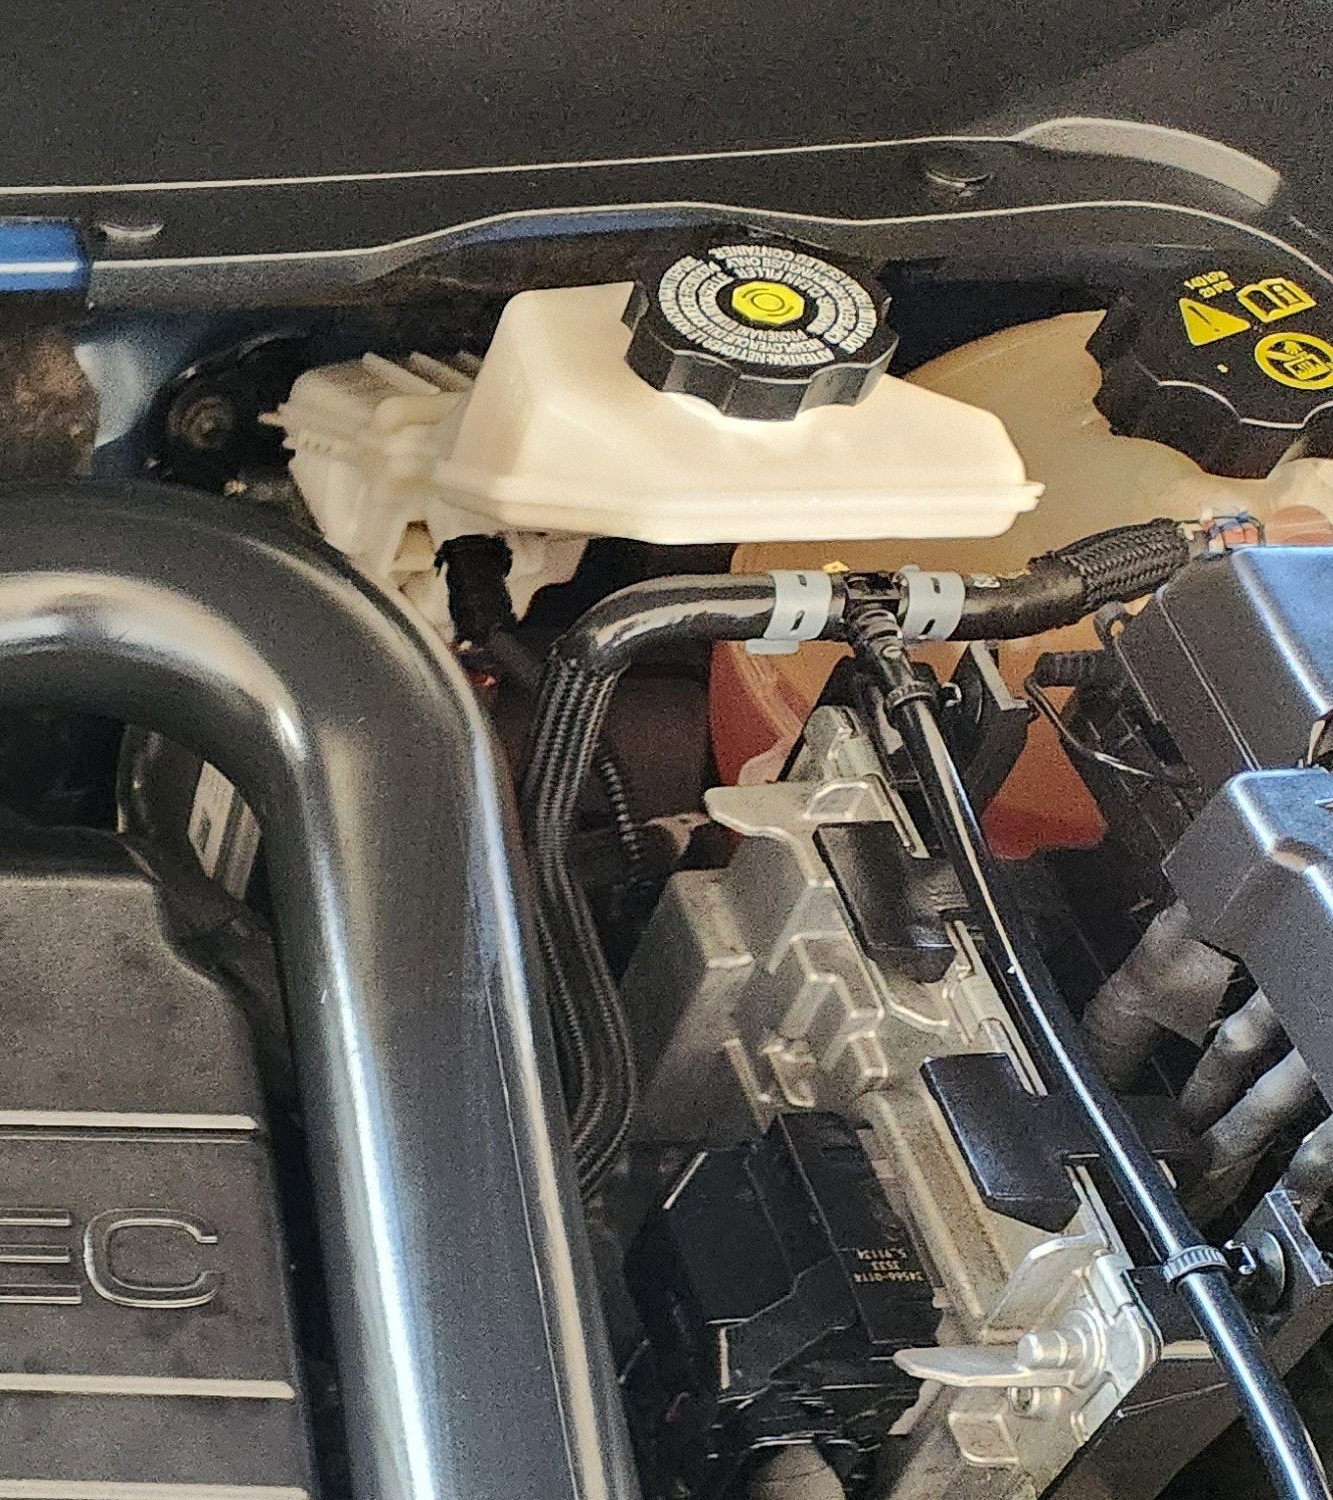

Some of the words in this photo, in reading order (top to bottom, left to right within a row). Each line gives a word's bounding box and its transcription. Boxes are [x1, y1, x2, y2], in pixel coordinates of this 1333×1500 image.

[723, 256, 761, 268] ONLY
[736, 268, 783, 281] FILLER
[781, 273, 826, 298] CLEAN
[721, 331, 751, 348] QUE
[702, 335, 765, 362] NETTOYER
